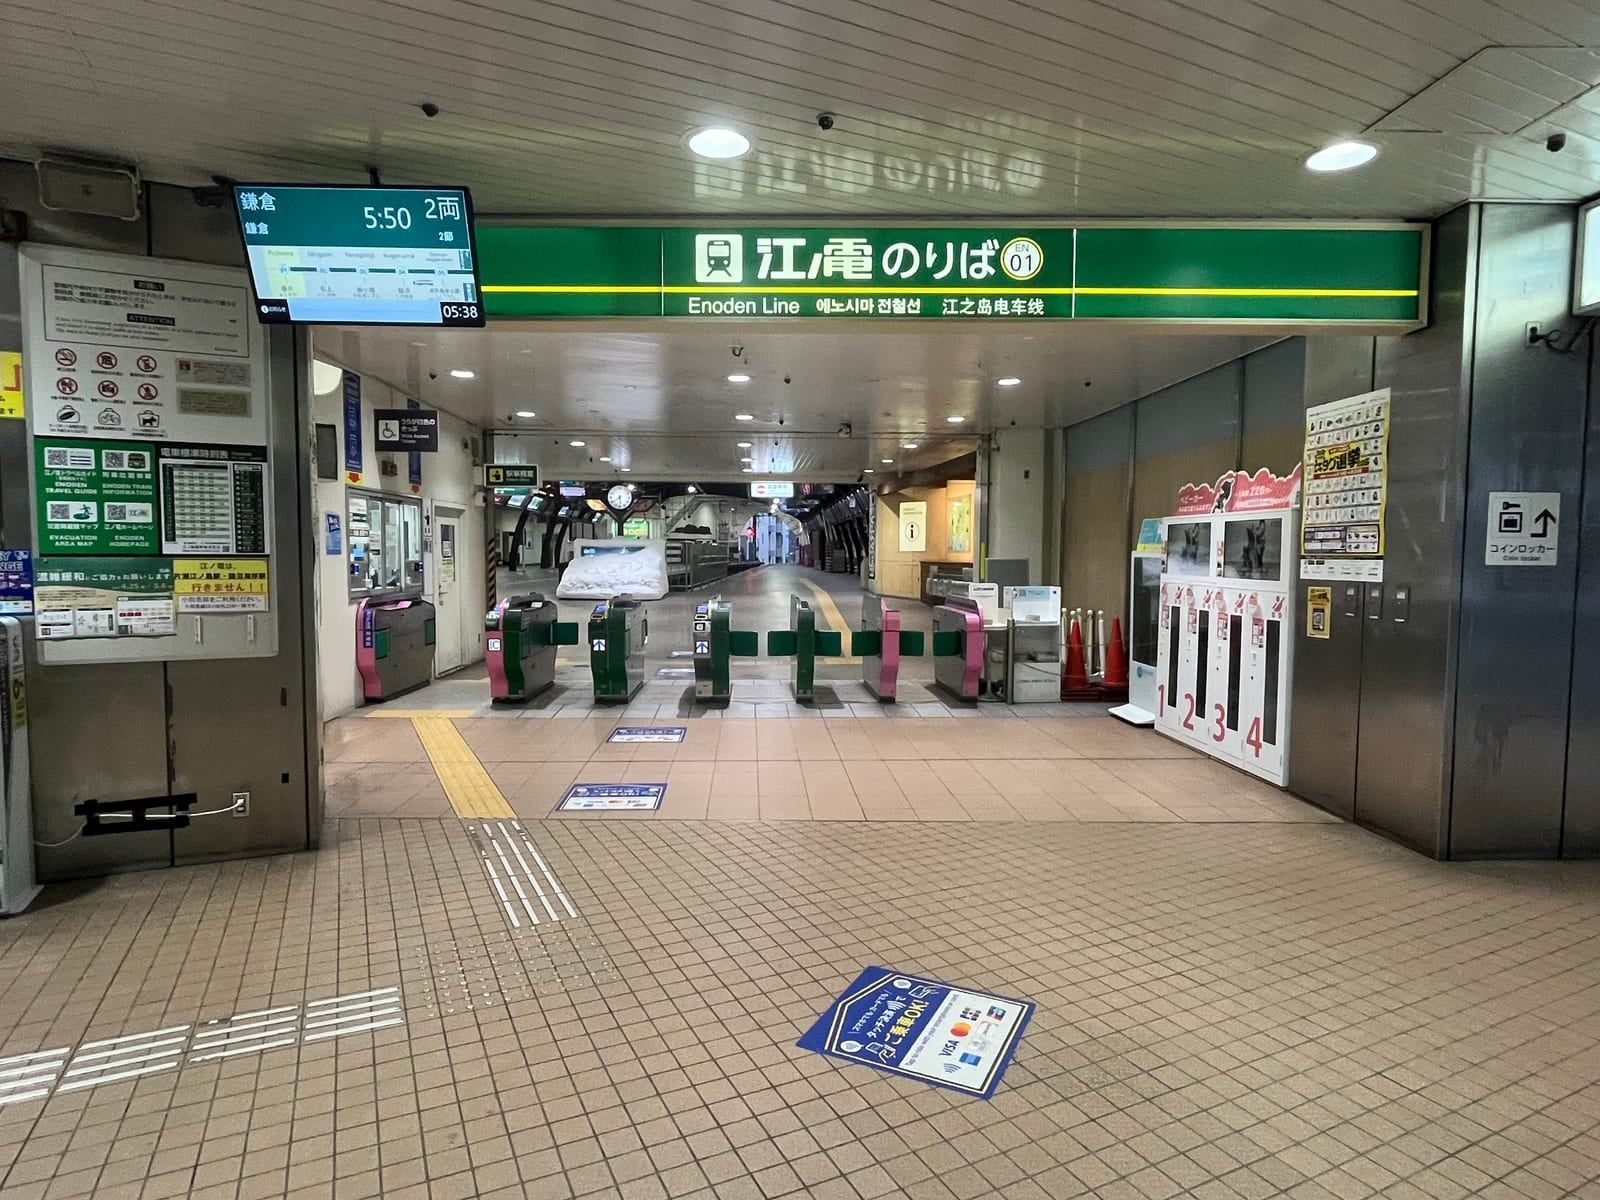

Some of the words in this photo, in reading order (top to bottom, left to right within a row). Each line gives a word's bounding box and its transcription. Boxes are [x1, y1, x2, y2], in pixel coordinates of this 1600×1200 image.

[240, 192, 276, 212] 鎌倉
[424, 197, 460, 221] 2両
[364, 206, 412, 230] 5:50
[1015, 244, 1029, 252] EN
[1010, 254, 1033, 272] 01
[442, 305, 478, 319] 05:38
[689, 298, 755, 314] Enoden
[763, 298, 800, 314] Line
[816, 297, 874, 314] 에노시마
[878, 297, 921, 314] 전철선
[941, 298, 1045, 316] 江之岛电车线
[1490, 544, 1556, 553] コインロッカー
[489, 640, 500, 649] IC
[1158, 684, 1165, 718] 1
[1182, 693, 1195, 731] 2
[1213, 703, 1226, 742] 3
[1246, 716, 1262, 758] 4
[939, 1038, 959, 1057] VISA
